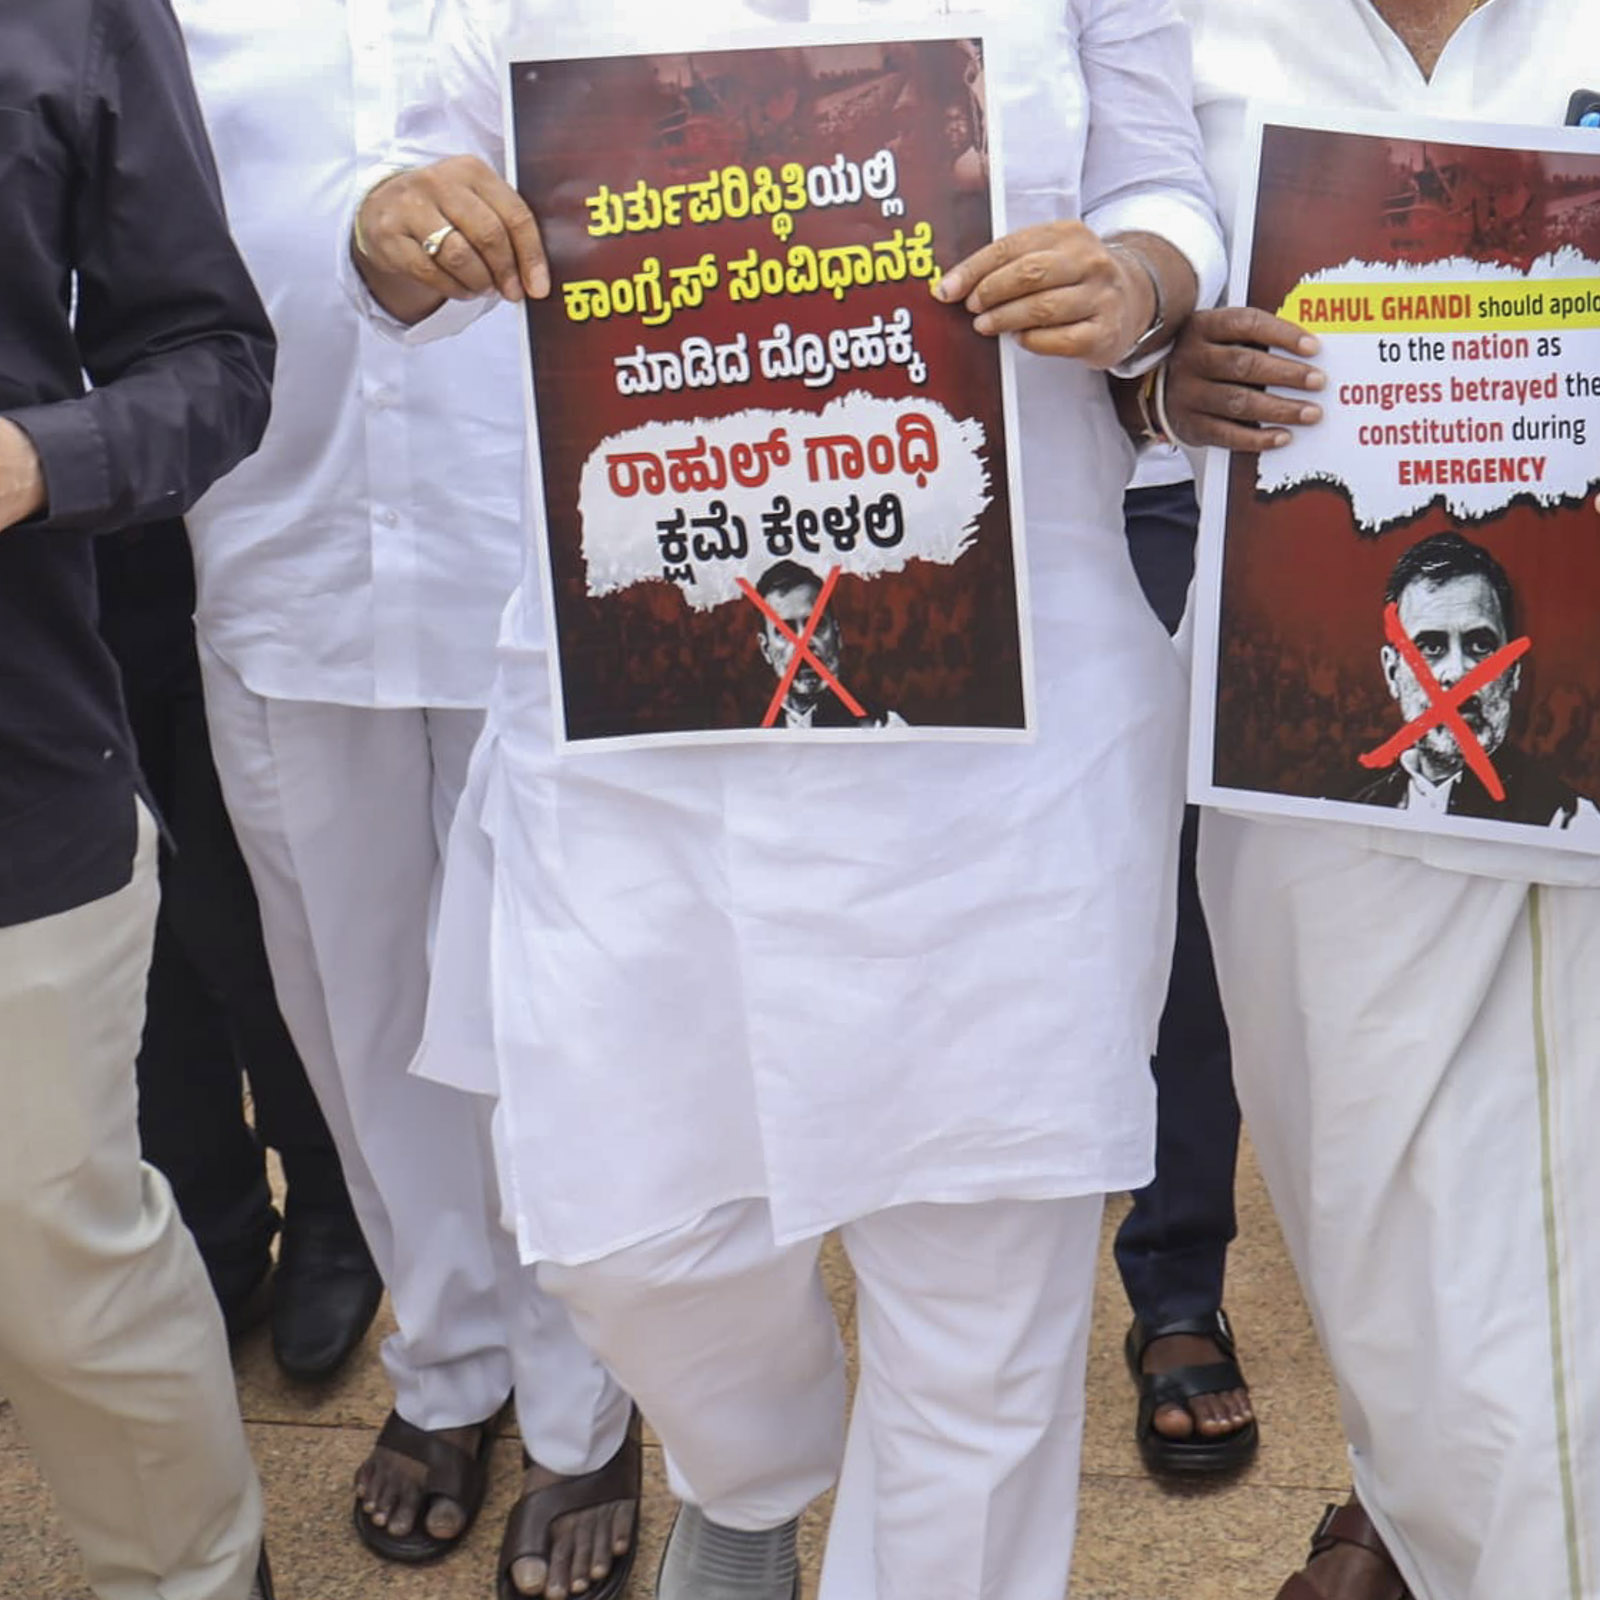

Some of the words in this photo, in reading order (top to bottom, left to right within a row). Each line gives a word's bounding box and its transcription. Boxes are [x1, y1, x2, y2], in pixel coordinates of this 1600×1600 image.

[585, 149, 904, 241] ತುರ್ತುಪರಿಸ್ಥಿತಿಯಲ್ಲಿ
[562, 254, 718, 325] ಕಾಂಗ್ರೆಸ್
[728, 221, 942, 301] ಸಂವಿಧಾನಕ್ಕೆ
[1299, 298, 1374, 322] RAHUL
[1382, 294, 1471, 321] GHANDI
[1478, 294, 1543, 318] should
[614, 332, 749, 395] ಮಾಡಿದ
[759, 307, 927, 386] ದ್ರೋಹಕ್ಕೆ
[1378, 339, 1401, 362] to
[1408, 337, 1445, 361] the
[1452, 334, 1529, 360] nation
[1537, 336, 1561, 357] as
[1339, 381, 1443, 411] congress
[1450, 373, 1558, 410] betrayed
[606, 427, 790, 497] ರಾಹುಲ್
[804, 412, 939, 488] ಗಾಂಧಿ
[1358, 418, 1504, 445] constitution
[1512, 415, 1586, 445] during
[1398, 456, 1546, 485] EMERGENCY
[656, 500, 748, 584] ಕ್ಷಮೆ
[761, 493, 904, 556] ಕೇಳಲಿ
